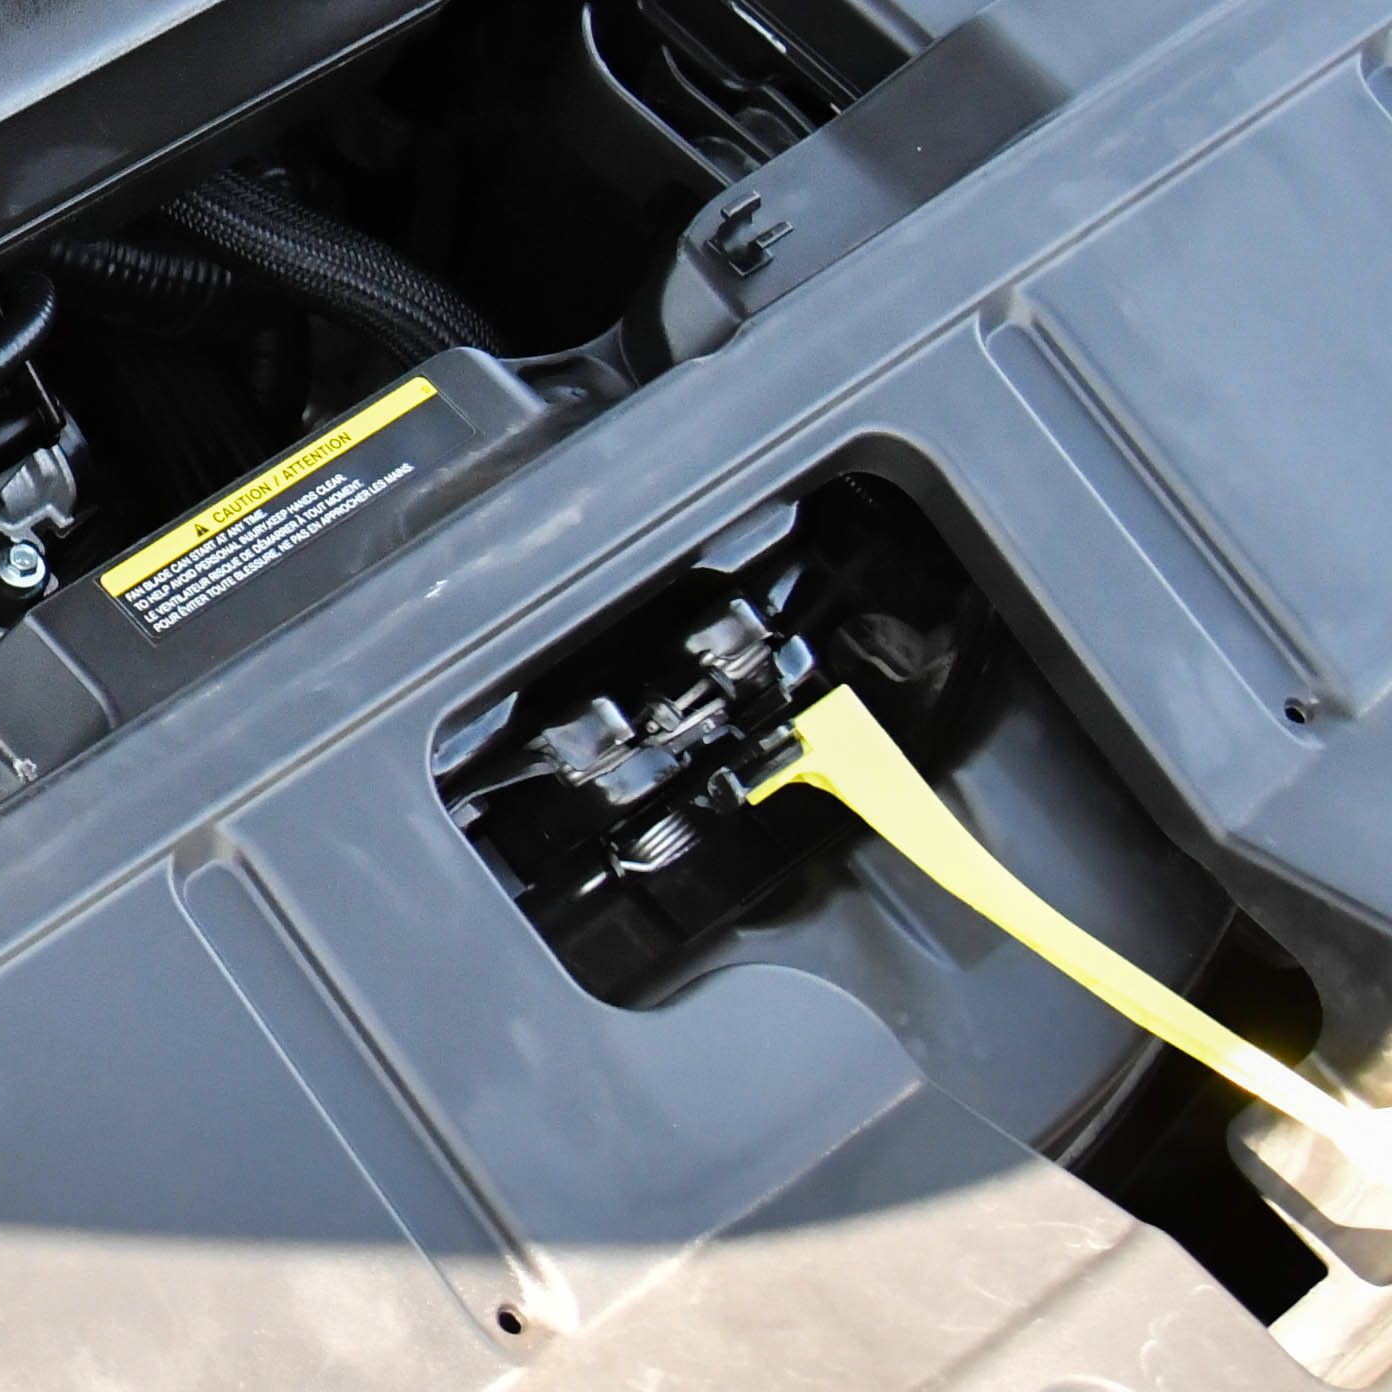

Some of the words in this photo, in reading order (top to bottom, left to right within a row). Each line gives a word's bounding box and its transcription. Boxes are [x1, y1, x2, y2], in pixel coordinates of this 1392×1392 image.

[211, 480, 272, 524] CAUTION
[271, 475, 281, 486] /
[281, 429, 352, 480] ATTENTION
[124, 584, 145, 602] FAN
[142, 568, 172, 591] BLADE
[169, 555, 191, 574] CAN
[188, 539, 217, 561] START
[214, 531, 228, 545] AT
[225, 521, 245, 538] ANY
[133, 598, 149, 612] TO
[146, 584, 171, 604] HELP
[169, 567, 197, 589] AVOID
[195, 539, 242, 573] PERSONAL
[286, 489, 318, 514] HANDS
[143, 610, 157, 623] LE
[153, 576, 211, 617] VENTILATEUR
[208, 556, 242, 582] RISQUE
[239, 548, 254, 562] DE
[250, 518, 299, 554] DÉMARRER
[294, 512, 306, 525] À
[303, 500, 328, 521] TOUT
[153, 611, 181, 634] POUR
[176, 590, 209, 617] ÉVITER
[206, 575, 236, 598] TOUTE
[277, 537, 294, 553] NE
[290, 527, 310, 544] PAS
[306, 519, 322, 534] EN
[319, 488, 372, 526] APPROCHER
[368, 478, 387, 494] LES
